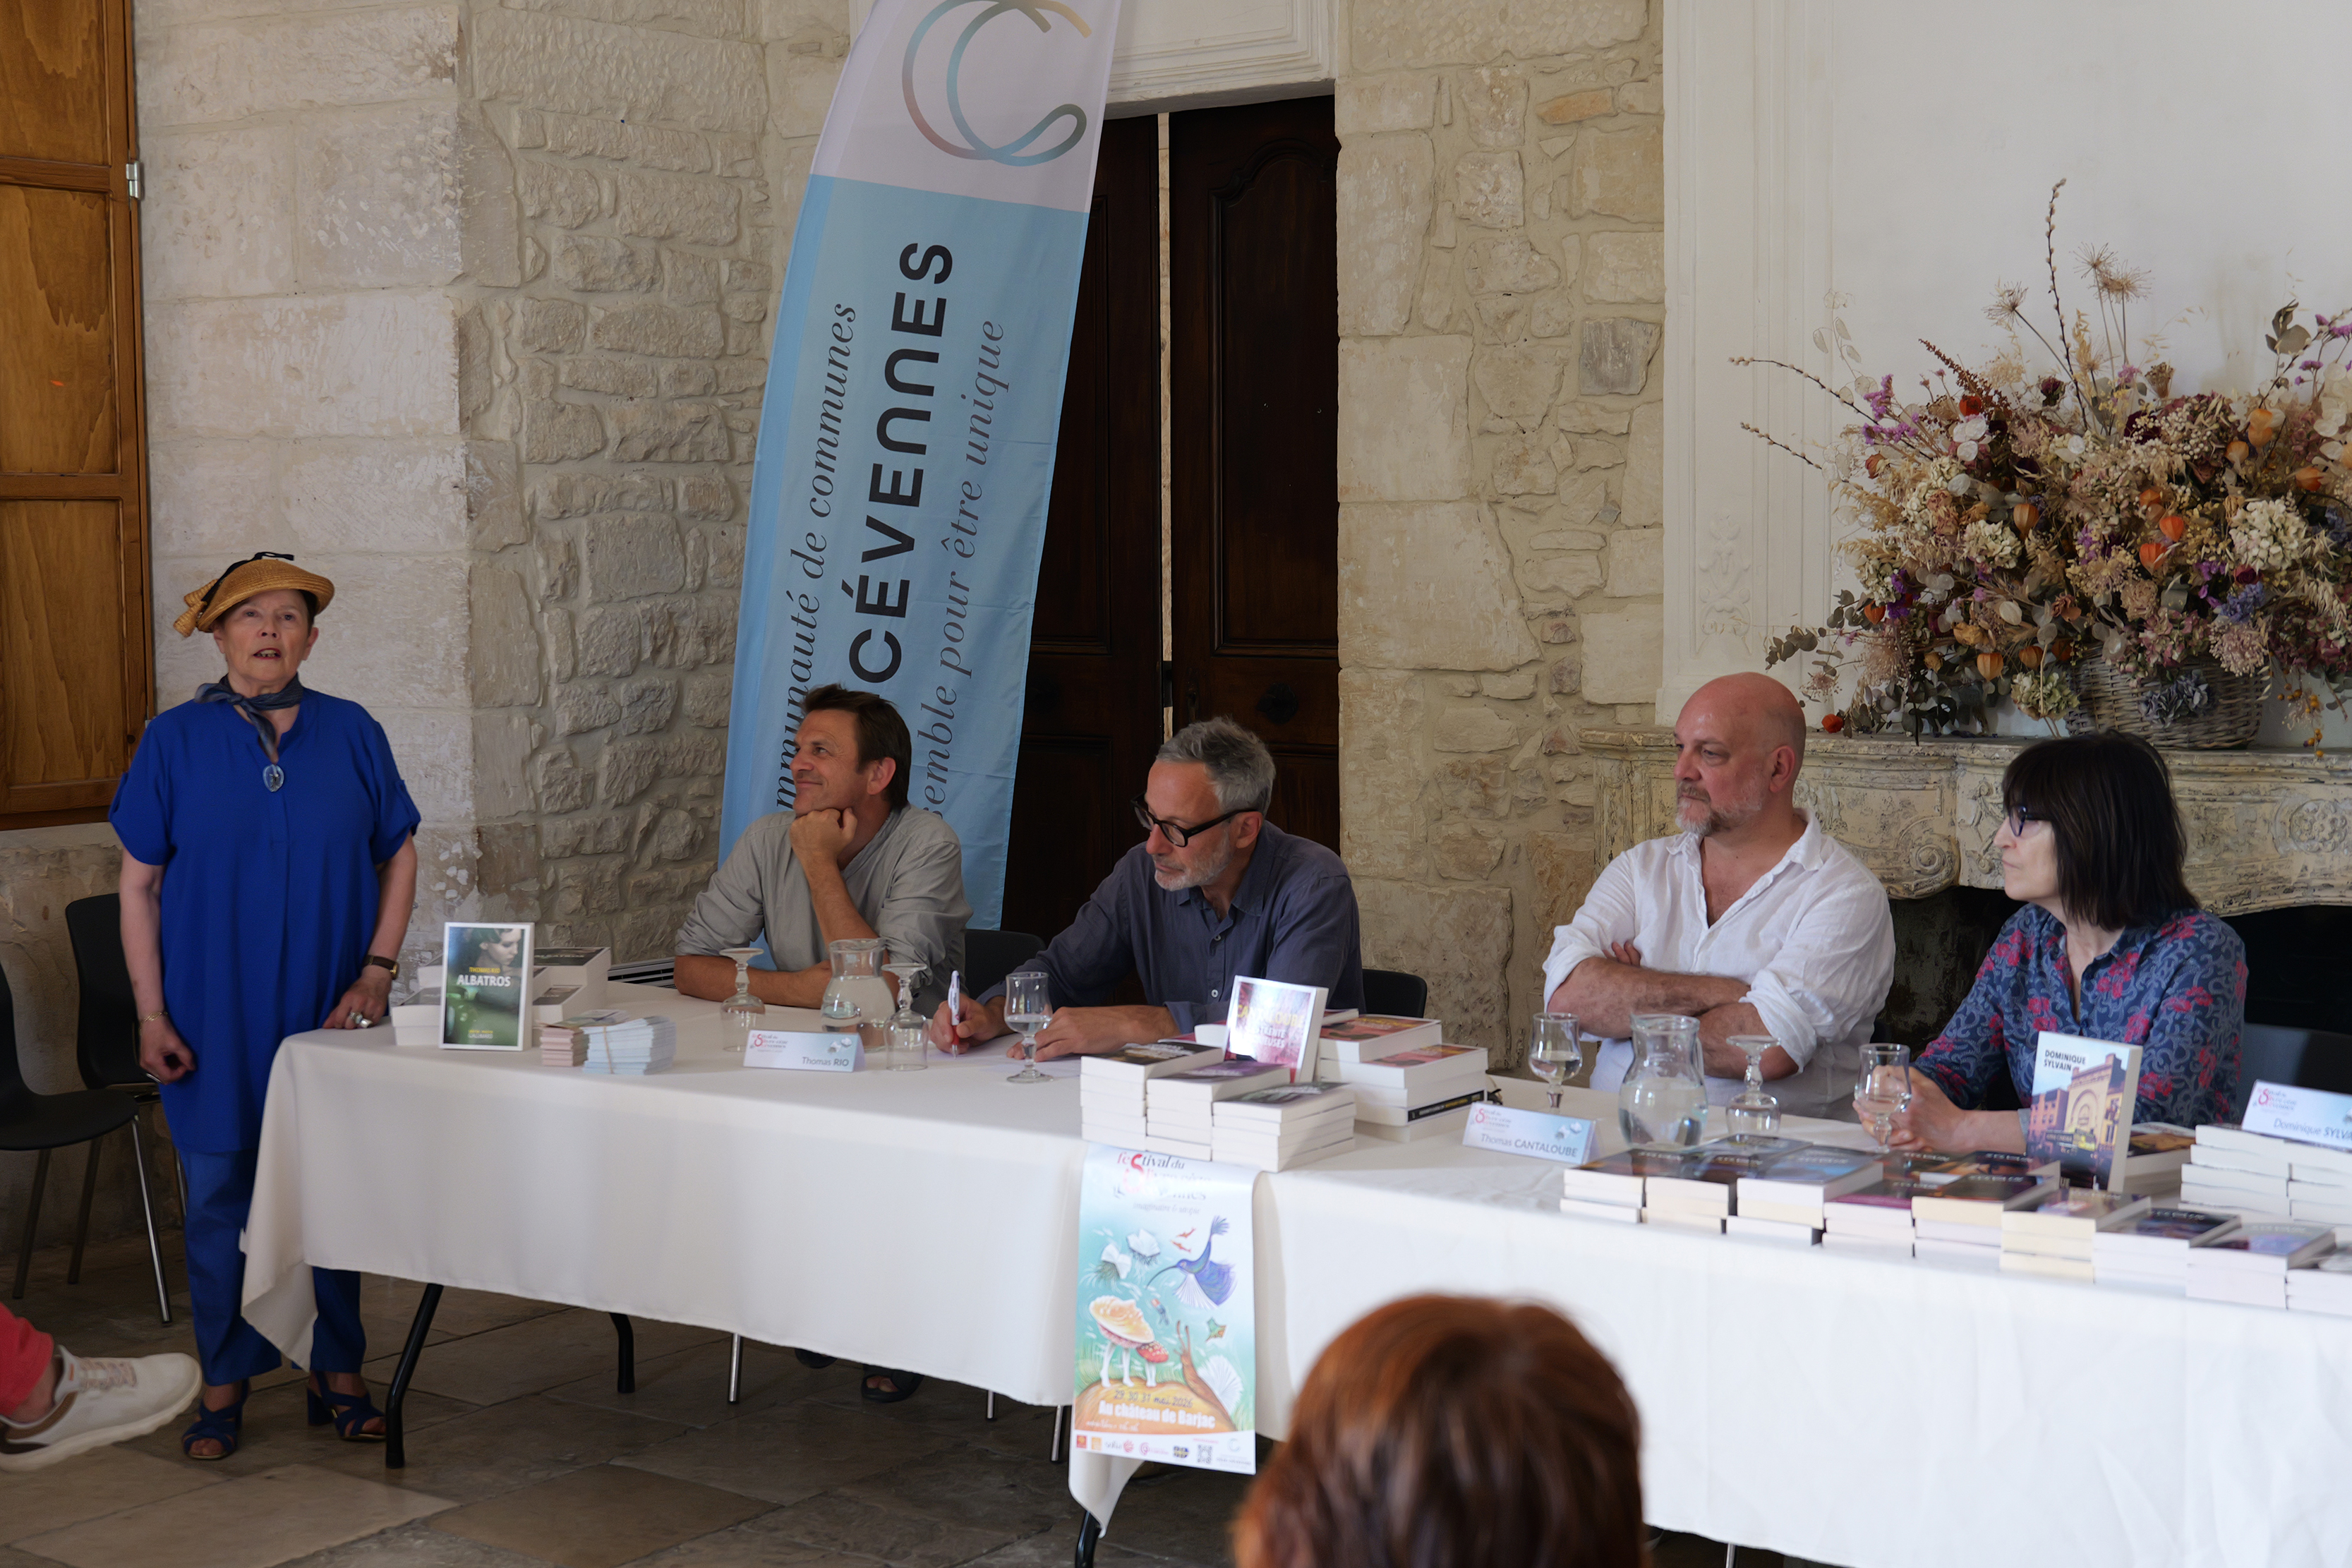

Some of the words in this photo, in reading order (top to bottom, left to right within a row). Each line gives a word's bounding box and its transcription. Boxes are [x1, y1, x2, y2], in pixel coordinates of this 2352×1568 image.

[809, 303, 856, 518] communes
[960, 320, 1009, 466] unique
[841, 243, 953, 684] CÉVENNES
[941, 481, 982, 558] être
[790, 531, 827, 579] de
[939, 571, 972, 679] pour
[777, 590, 820, 810] mmunauté
[917, 685, 957, 819] emble
[457, 974, 511, 987] ALBATROS
[802, 1056, 831, 1066] Thomas
[833, 1058, 850, 1067] RIO
[2044, 1049, 2086, 1066] DOMINIQUE
[2044, 1059, 2072, 1071] SYLVAIN
[1481, 1133, 1512, 1146] Thomas
[1514, 1138, 1579, 1158] CANTALOUBE
[2274, 1118, 2322, 1136] Dominique
[2323, 1126, 2352, 1140] SYLVA
[1171, 1158, 1186, 1170] du
[1098, 1399, 1114, 1416] Au
[1114, 1402, 1161, 1423] château
[1162, 1408, 1177, 1424] de
[1178, 1409, 1217, 1430] Barjac
